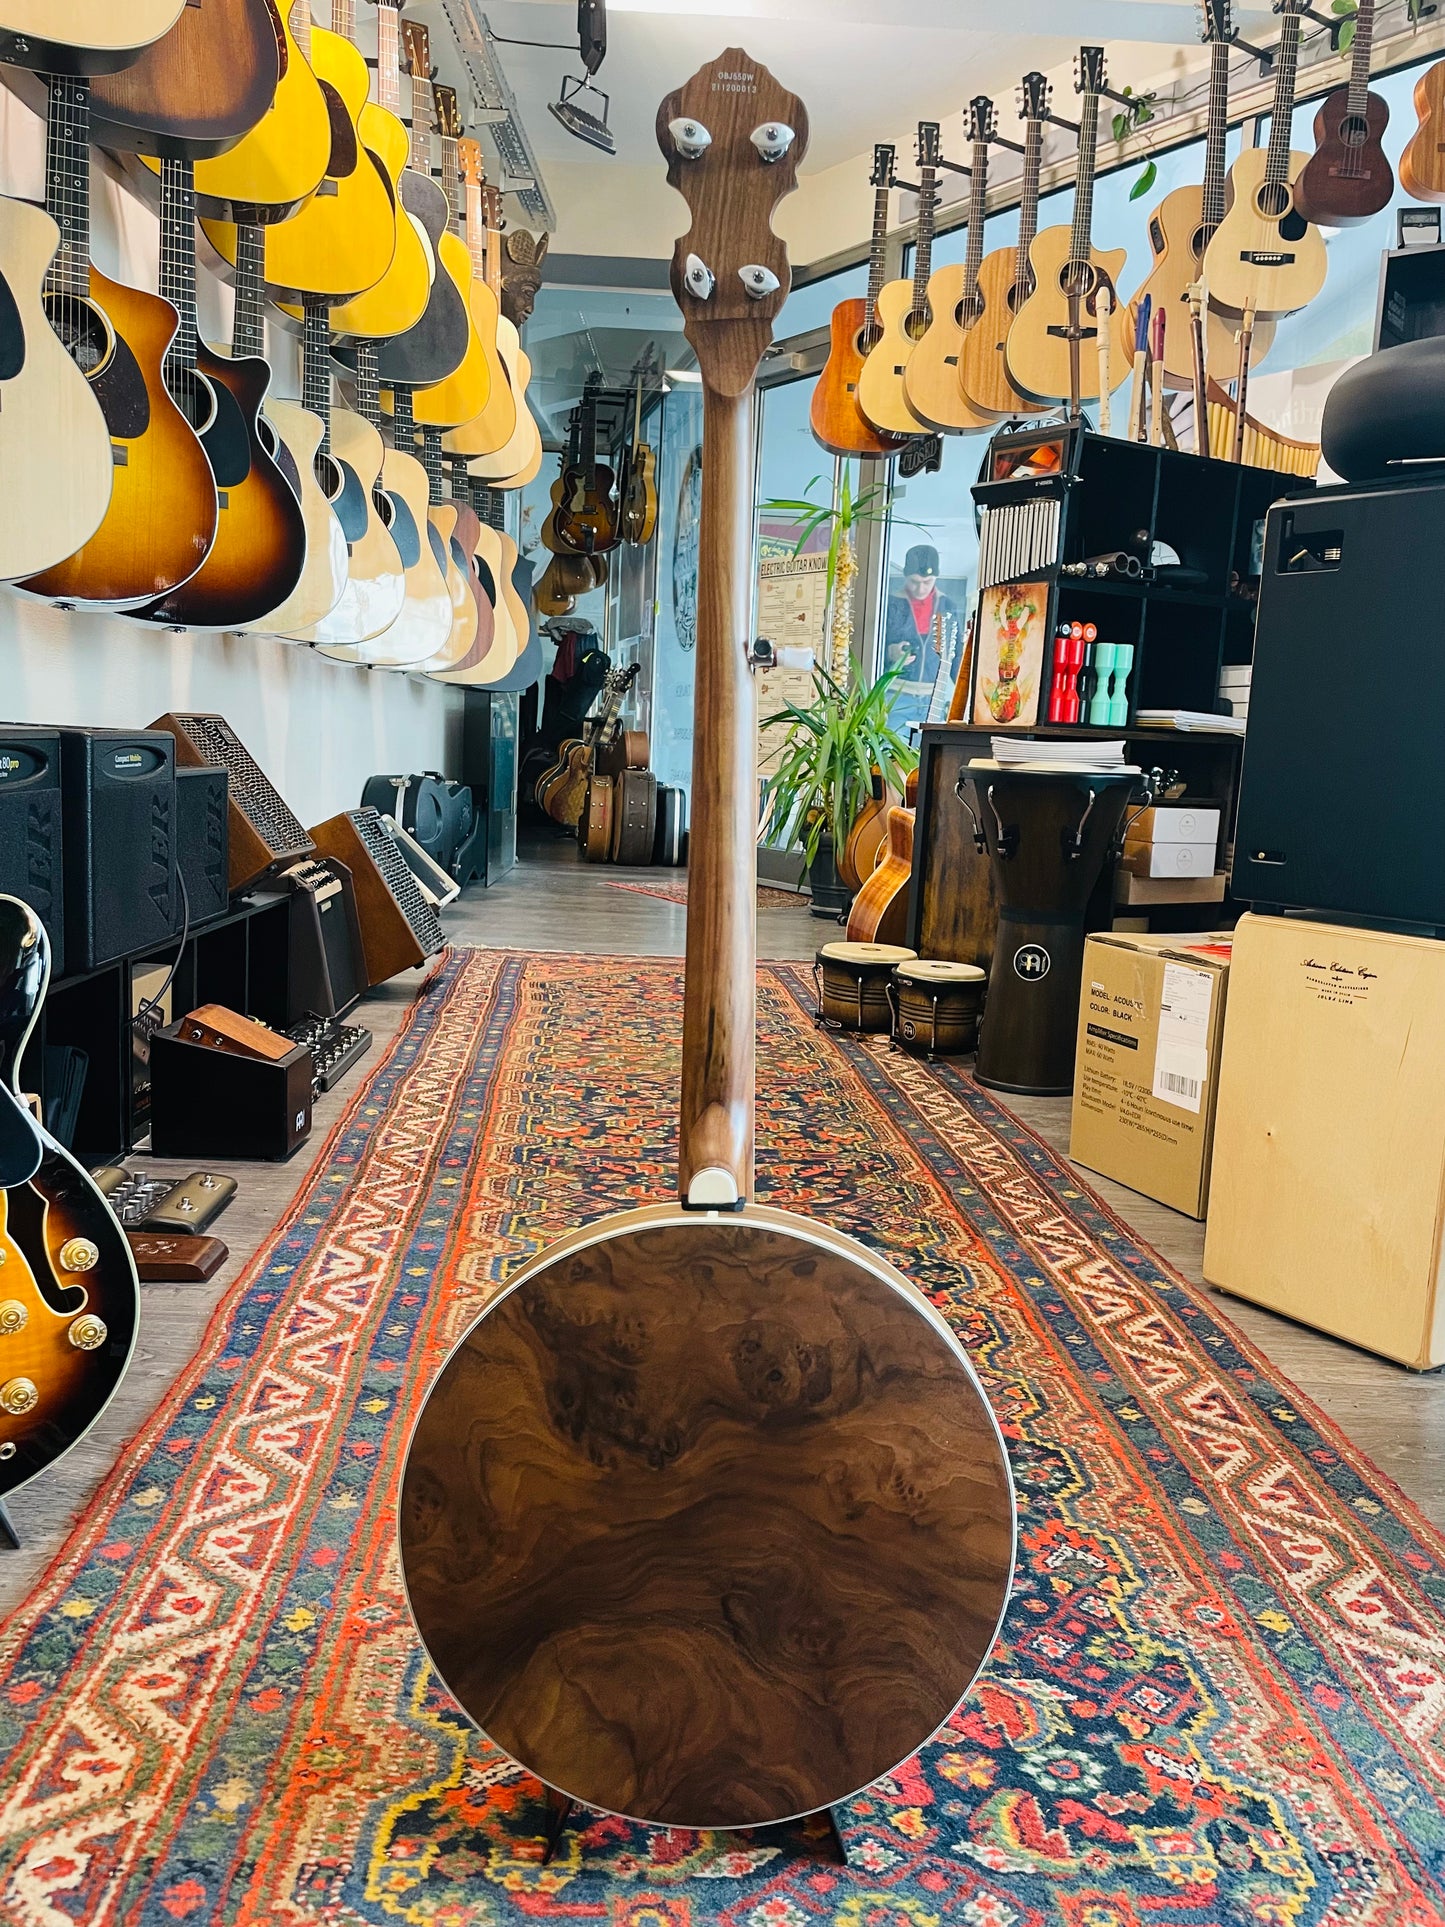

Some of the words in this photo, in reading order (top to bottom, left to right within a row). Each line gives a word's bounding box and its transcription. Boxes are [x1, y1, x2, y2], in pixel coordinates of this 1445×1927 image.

[718, 72, 754, 82] OBJ650W
[903, 439, 937, 471] CLOSED
[761, 562, 785, 576] ELECTRIC
[786, 559, 807, 573] GUITAR
[115, 755, 129, 764] Compact
[130, 754, 142, 762] Mobile
[203, 785, 224, 904] AER
[148, 794, 169, 926] AER
[1330, 961, 1354, 974] Edition
[1091, 988, 1111, 1001] MODEL:
[1089, 1002, 1111, 1015] COLOR:
[1112, 1009, 1133, 1022] BLACK
[1088, 1025, 1107, 1036] Amplifier
[1107, 1031, 1137, 1047] Specifications
[1172, 1119, 1181, 1127] use
